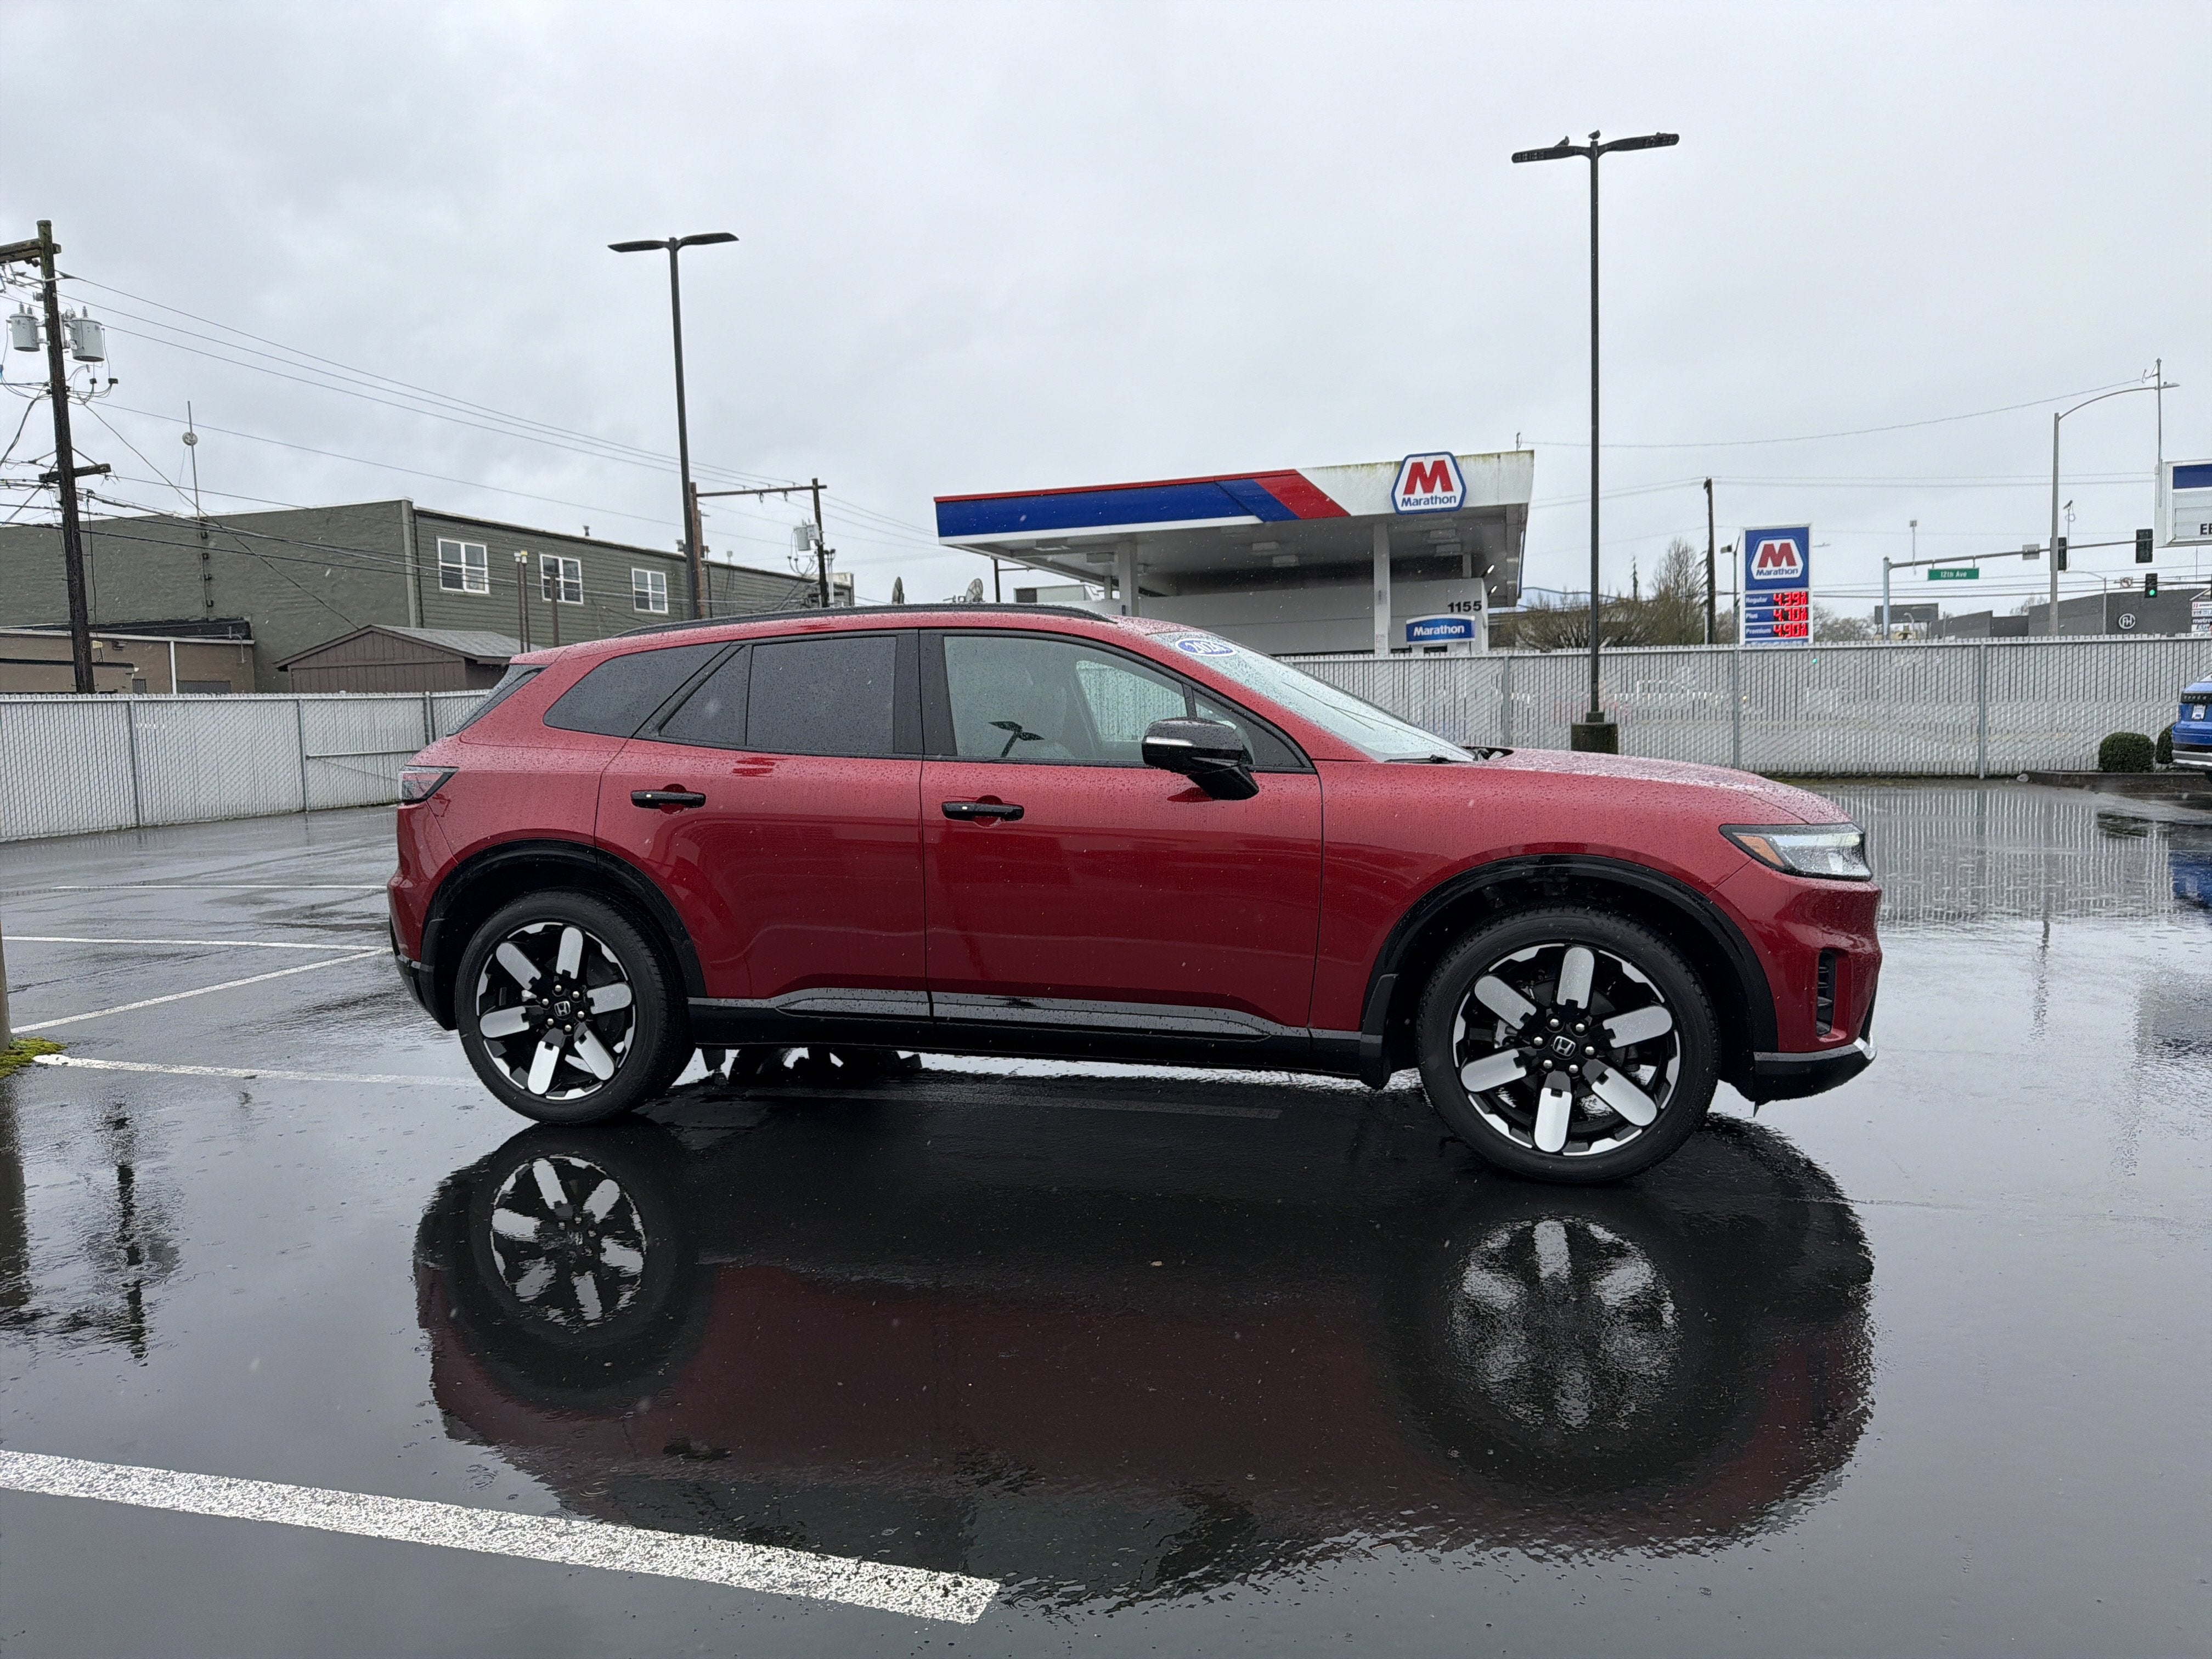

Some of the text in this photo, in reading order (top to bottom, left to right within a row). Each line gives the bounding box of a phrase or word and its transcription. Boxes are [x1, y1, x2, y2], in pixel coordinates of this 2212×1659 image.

[1403, 460, 1454, 495] M
[1401, 495, 1457, 507] Marathon
[1757, 543, 1797, 568] M
[1756, 568, 1798, 577] Marathon
[1447, 601, 1482, 613] 1155
[1413, 624, 1465, 636] Marathon
